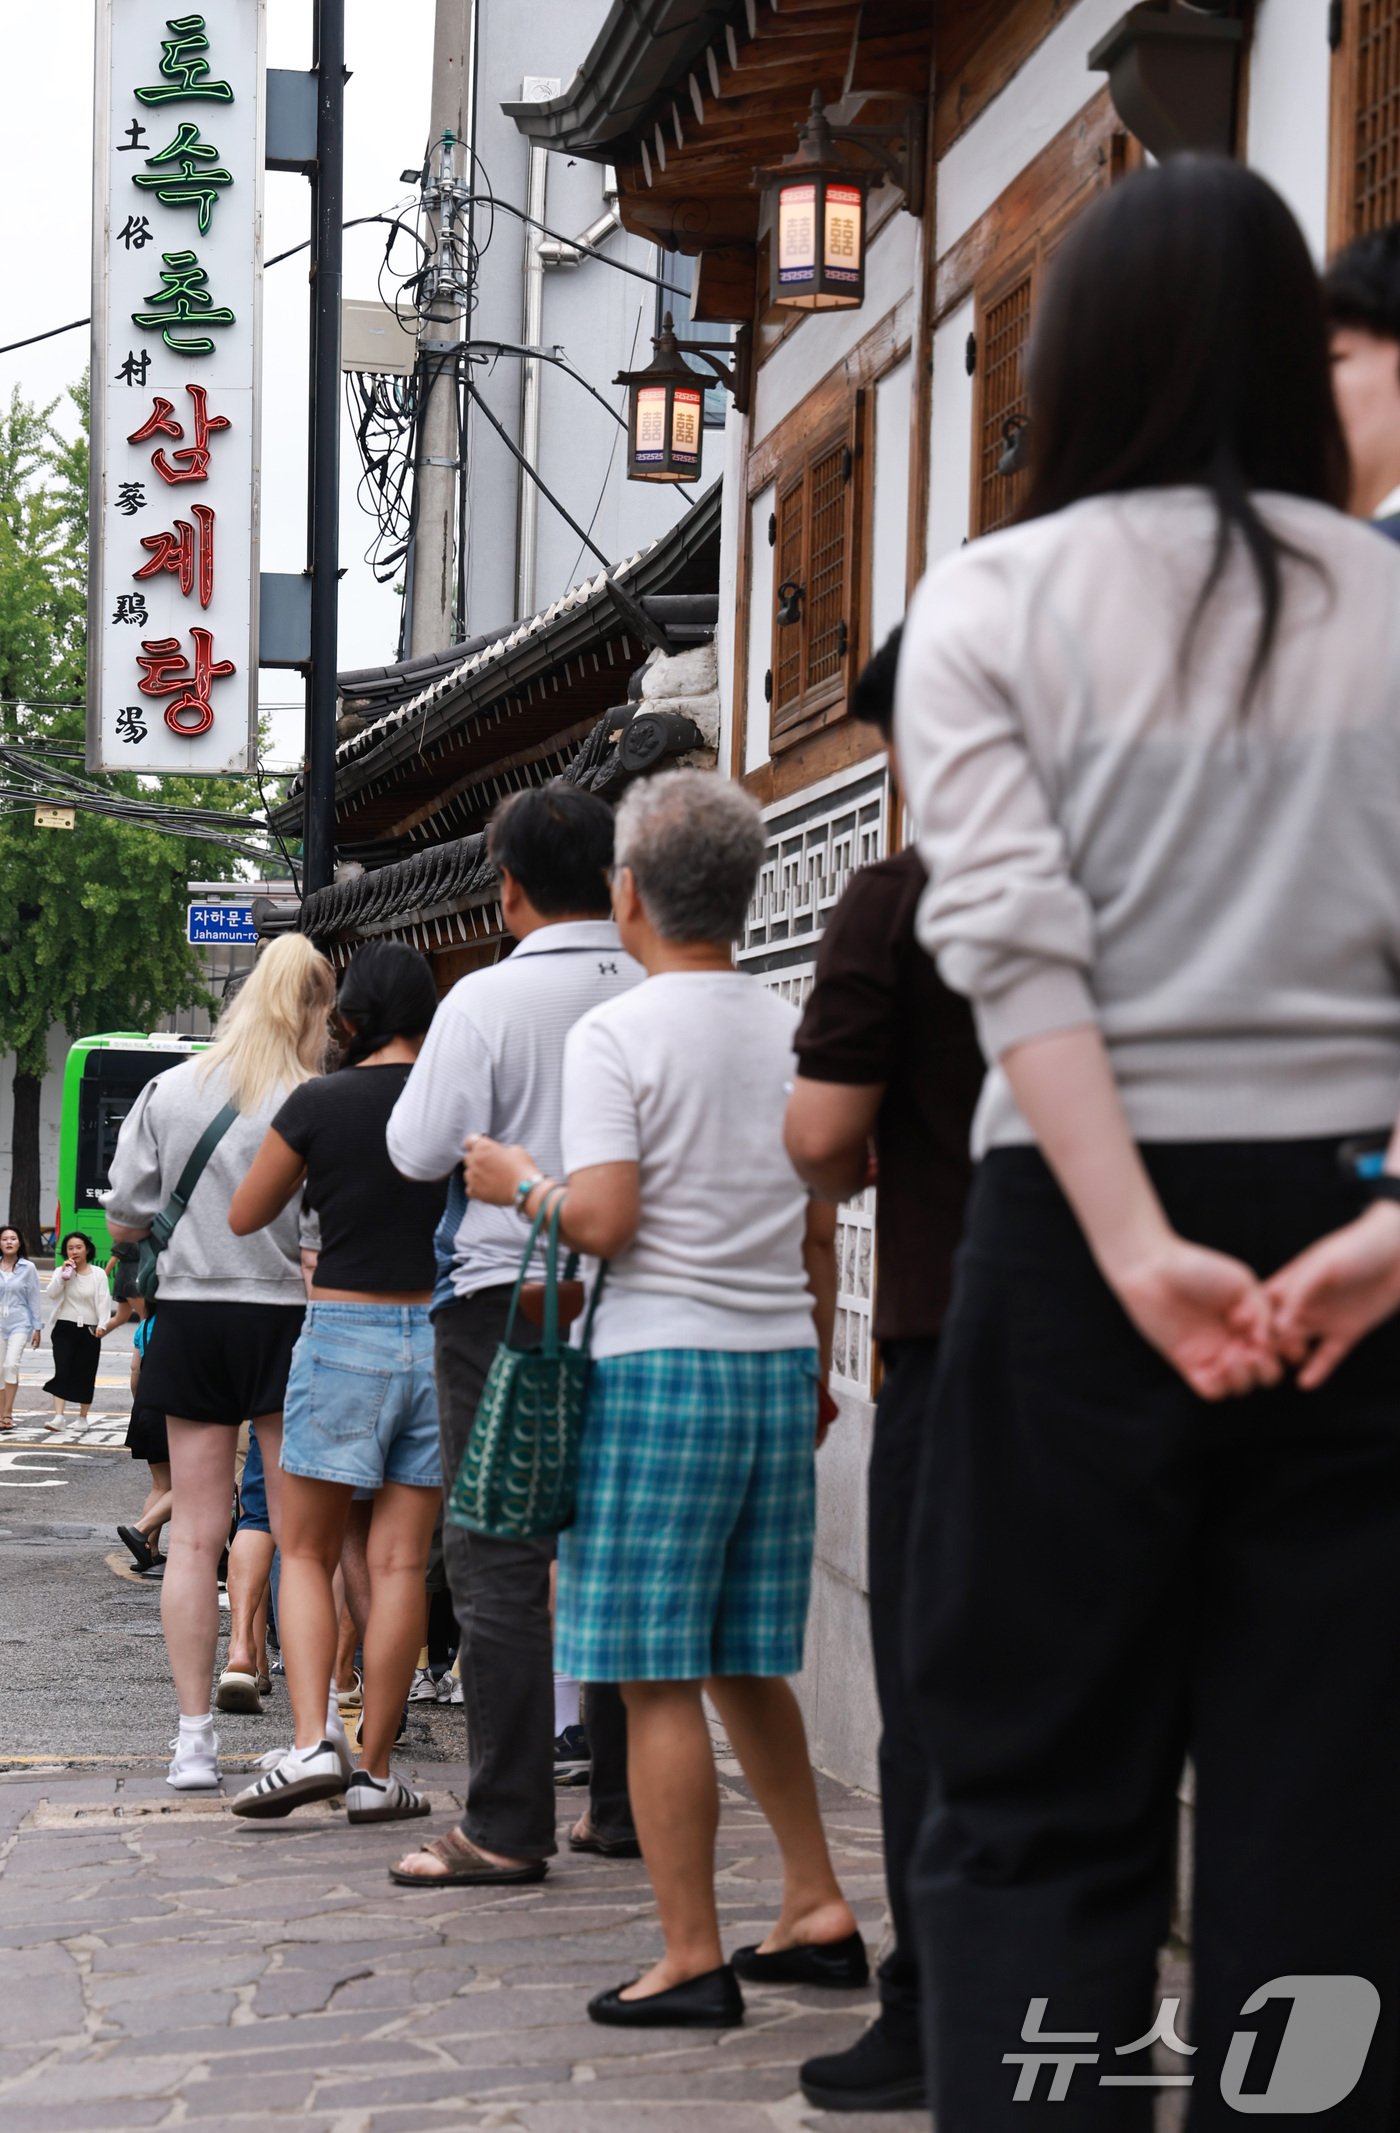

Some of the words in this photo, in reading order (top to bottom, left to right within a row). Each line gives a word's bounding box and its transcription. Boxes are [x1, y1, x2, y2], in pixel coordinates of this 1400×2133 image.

[131, 14, 236, 355] 토속촌
[127, 383, 236, 737] 삼계탕
[193, 929, 259, 940] Jahamun-ro
[194, 910, 254, 927] 자하문로
